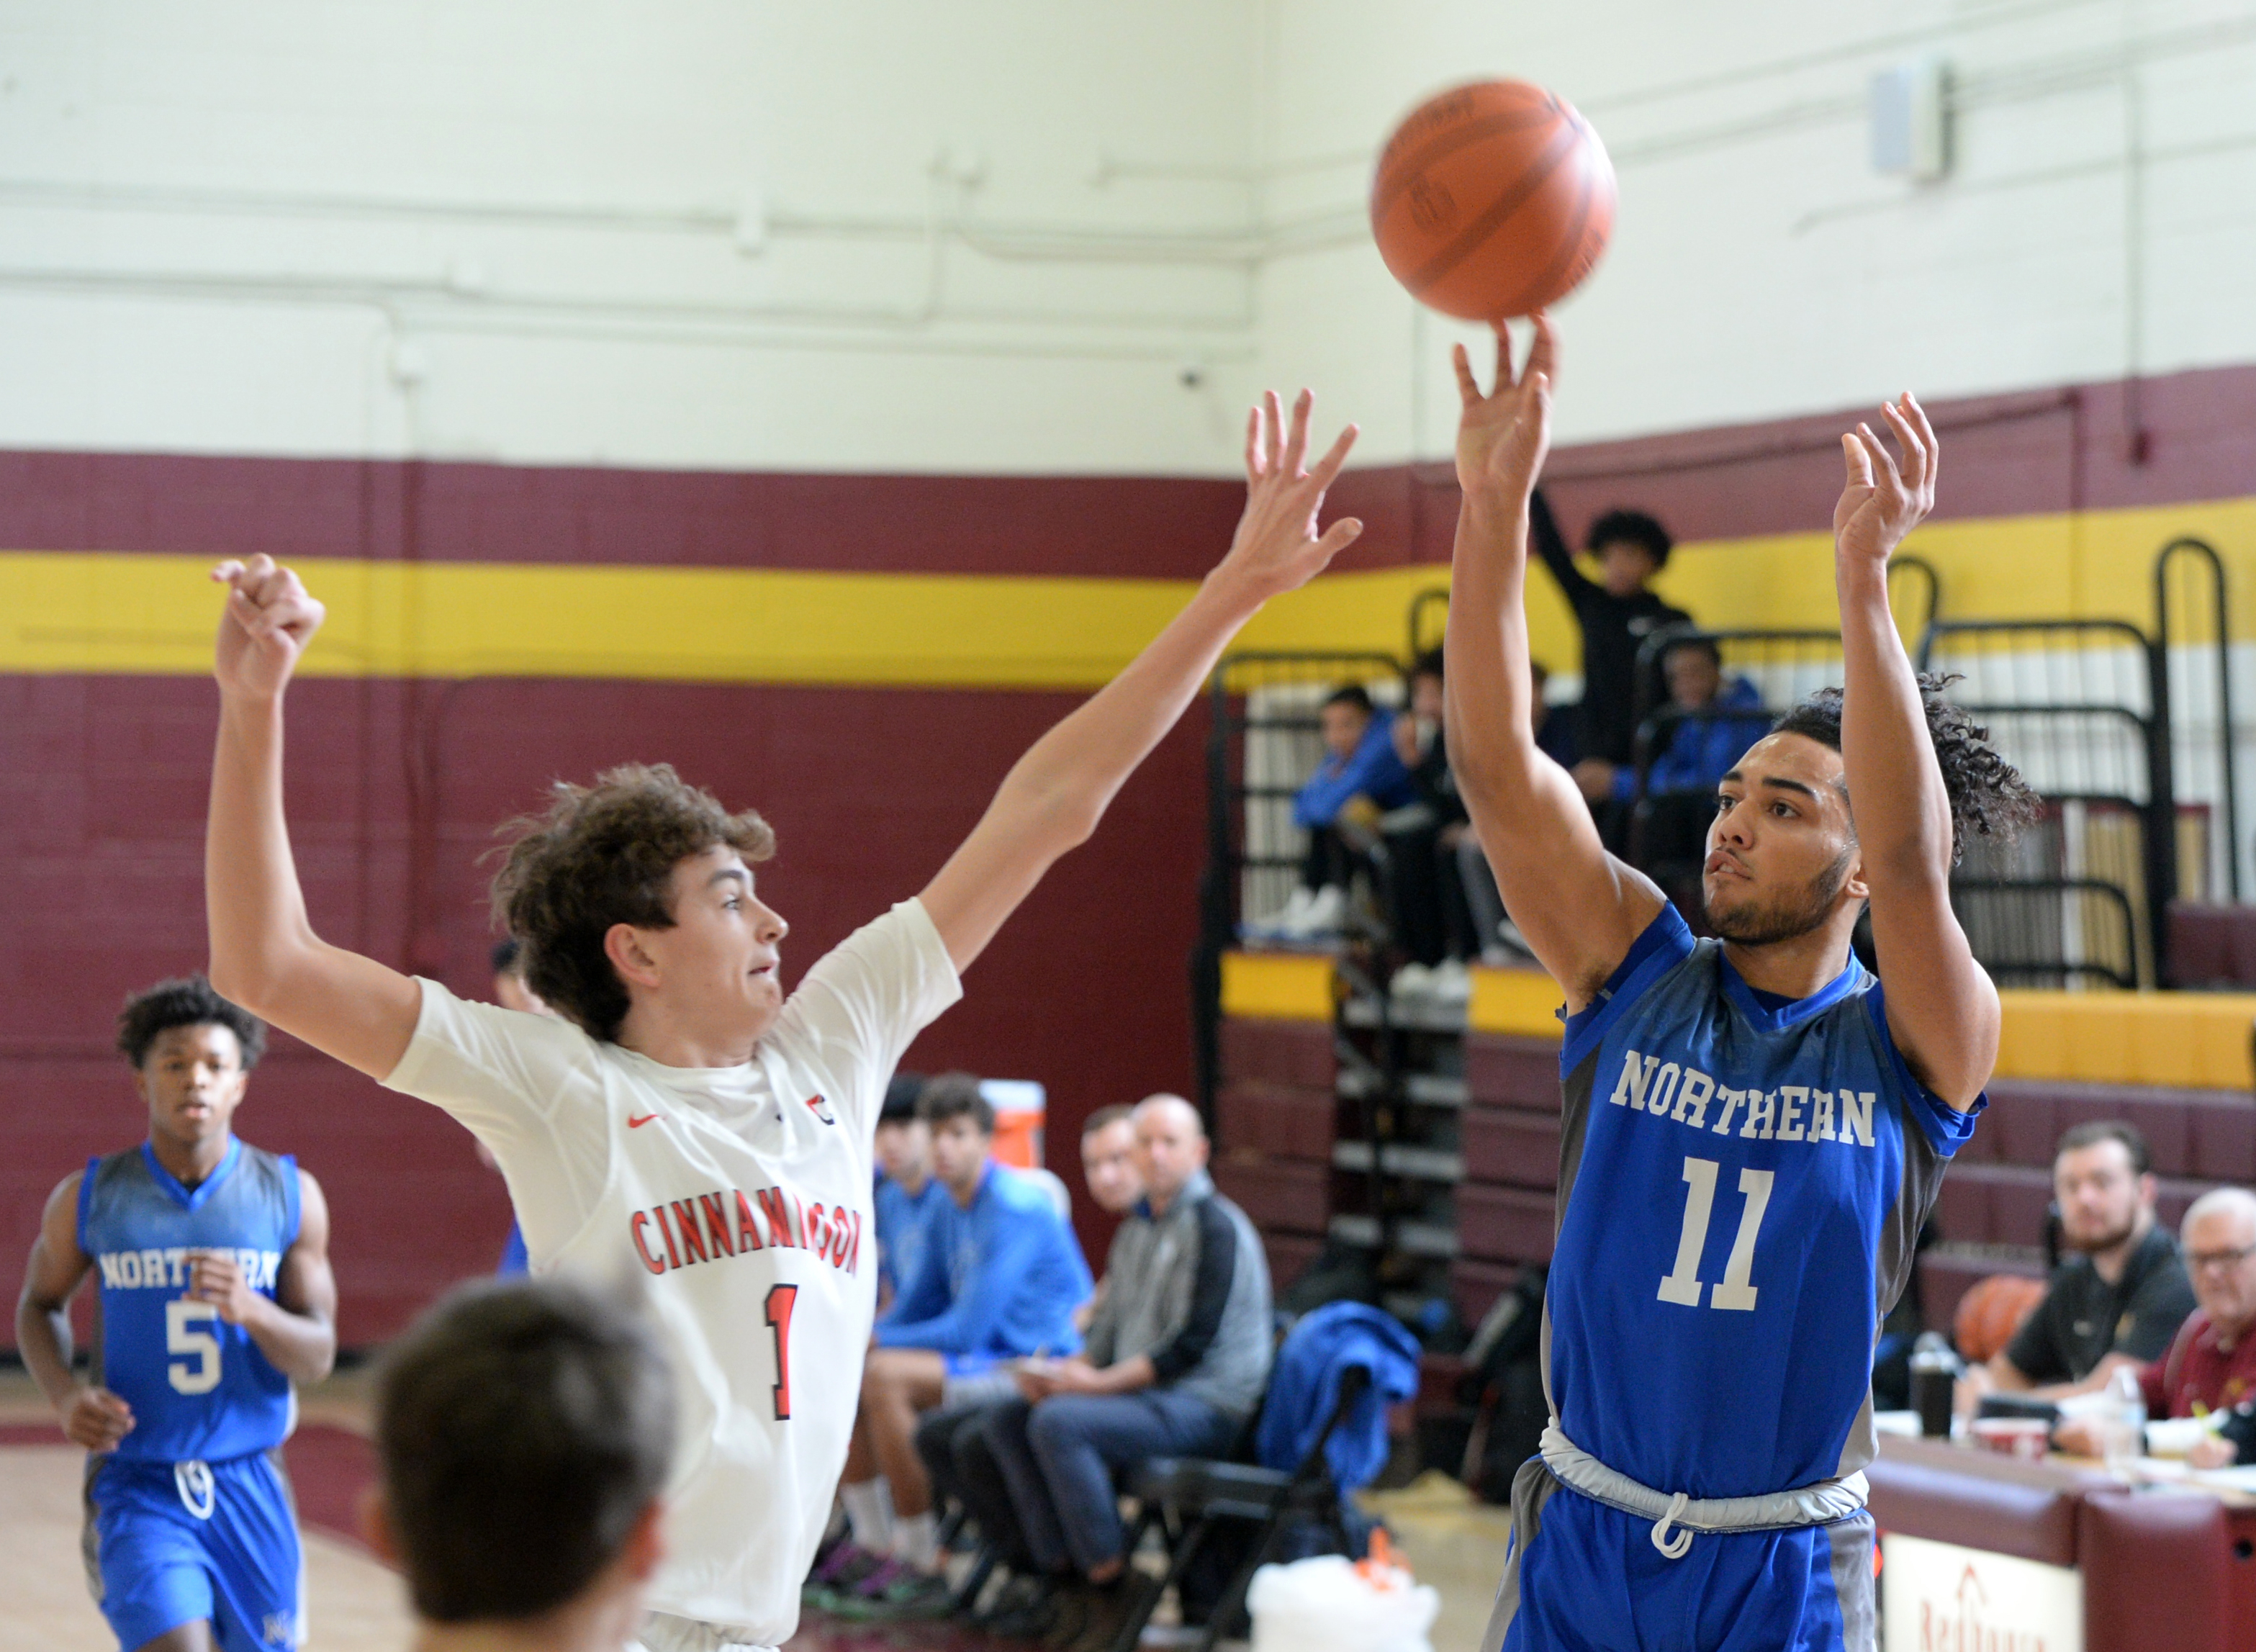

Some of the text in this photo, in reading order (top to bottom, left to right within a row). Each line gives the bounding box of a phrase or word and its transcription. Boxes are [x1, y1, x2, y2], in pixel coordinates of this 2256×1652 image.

[1610, 1050, 1875, 1147] NORTHERN
[99, 1247, 281, 1289] NORTRN
[1656, 1156, 1774, 1311] 11
[165, 1300, 222, 1395] 5
[764, 1283, 798, 1420] 1
